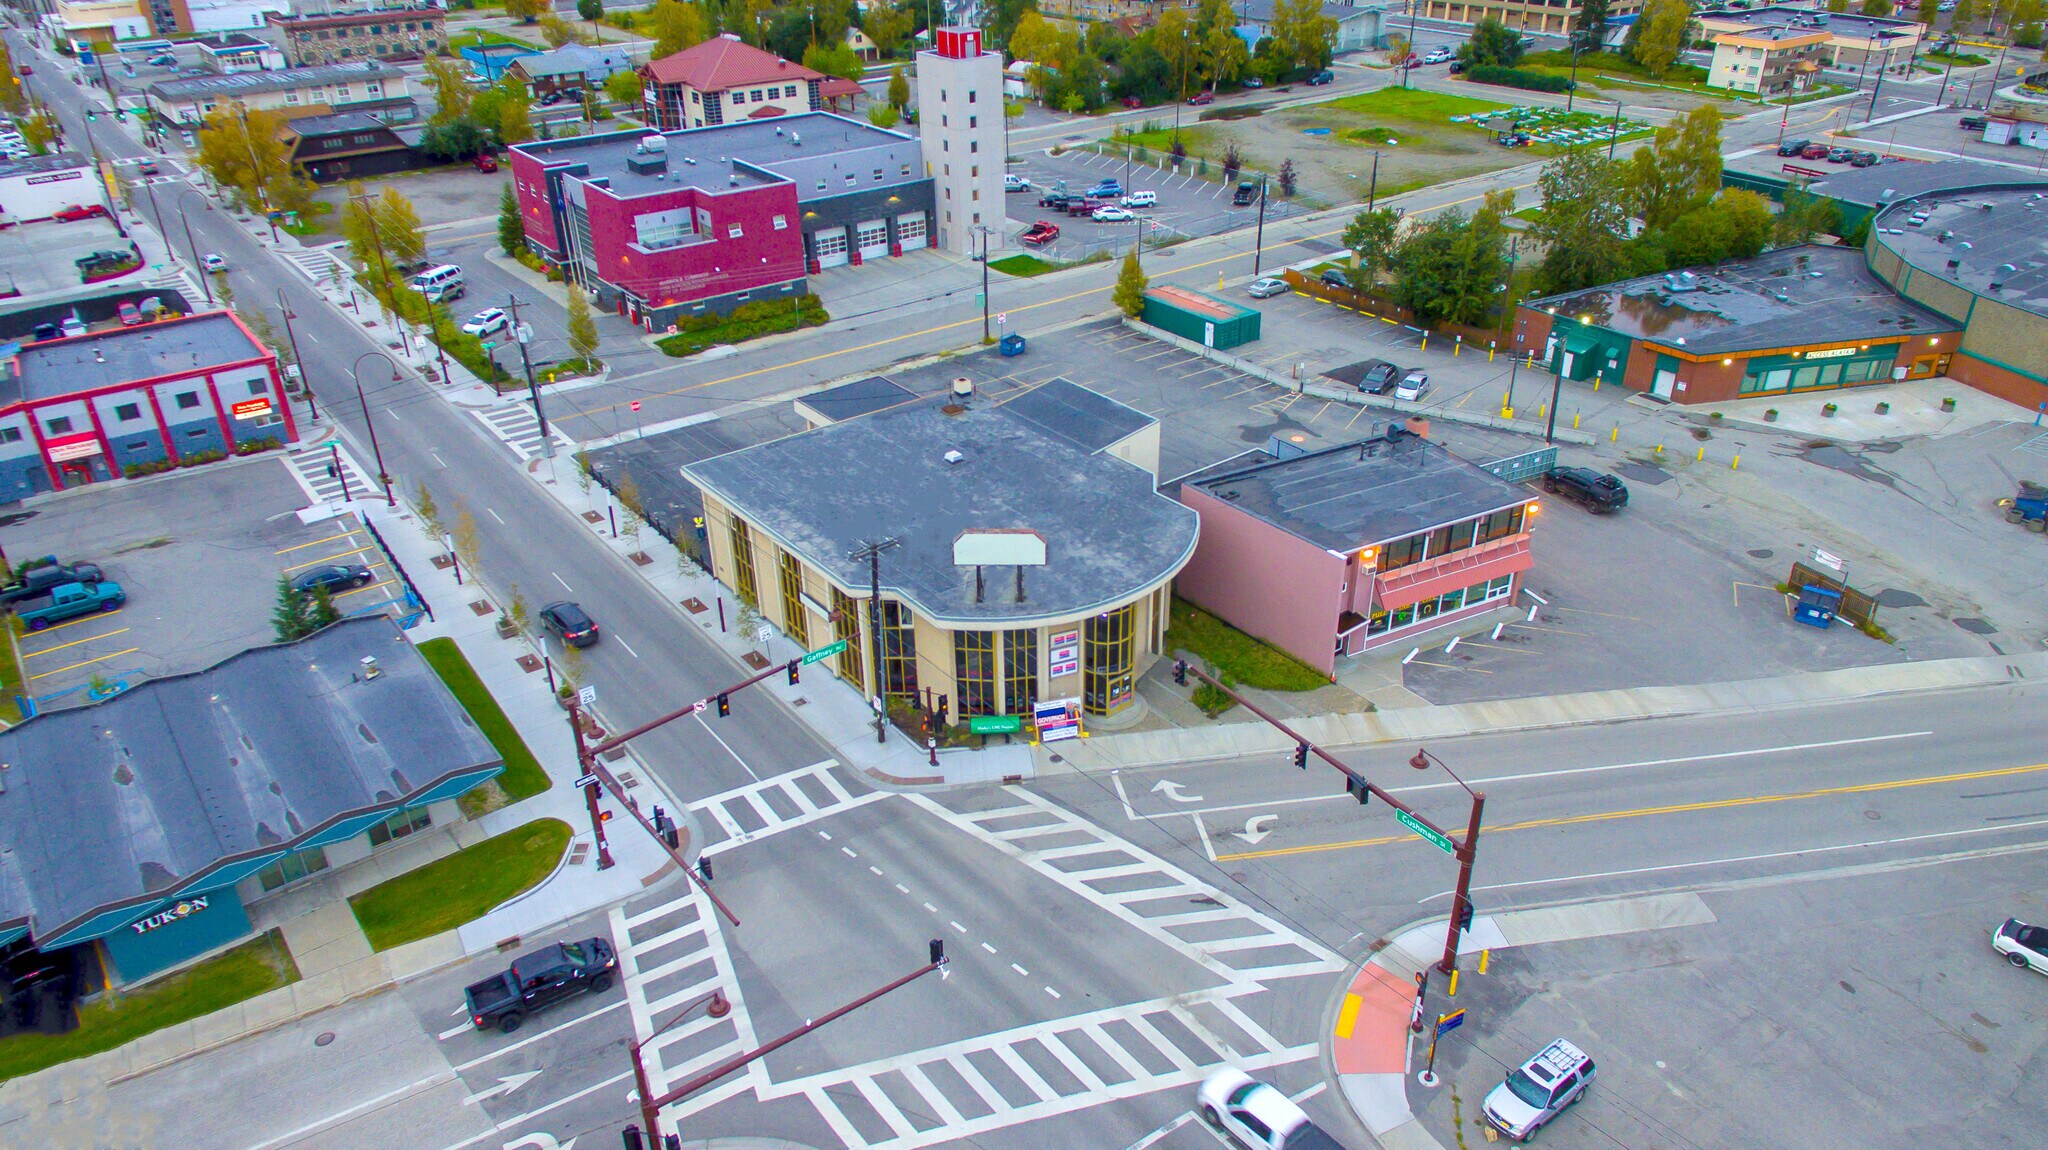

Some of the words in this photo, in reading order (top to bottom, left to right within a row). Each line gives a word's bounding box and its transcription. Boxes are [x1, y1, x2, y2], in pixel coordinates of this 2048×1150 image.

[1808, 351, 1830, 359] ACCESS
[1831, 348, 1855, 357] ALASKA
[1371, 609, 1387, 619] PULL
[806, 648, 833, 663] Gaffney
[582, 695, 594, 703] 25
[1036, 713, 1066, 724] GOVERNOR
[1401, 815, 1437, 842] Cushman
[131, 895, 209, 934] YUKON
